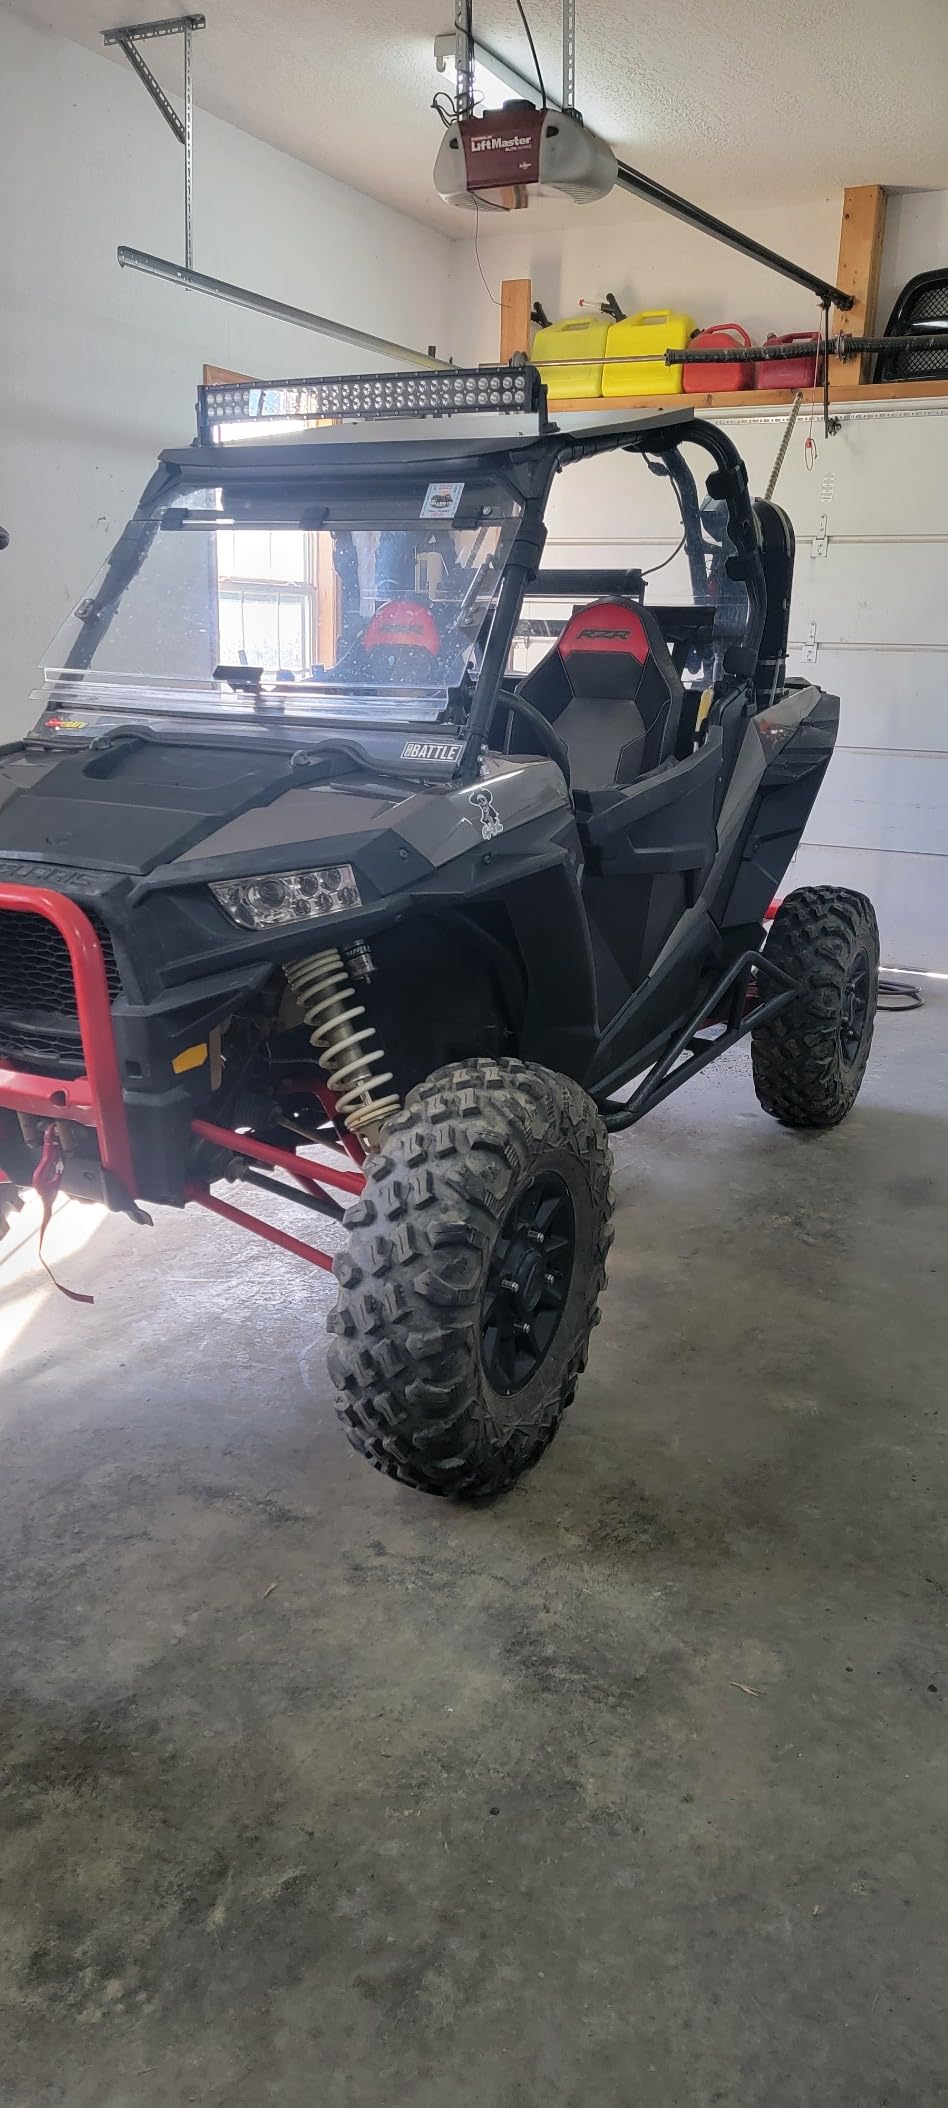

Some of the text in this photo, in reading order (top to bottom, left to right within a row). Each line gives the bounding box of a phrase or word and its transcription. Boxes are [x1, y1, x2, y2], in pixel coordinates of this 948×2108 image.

[471, 136, 532, 152] LiftMaster
[575, 629, 631, 641] RZR
[410, 744, 459, 760] BATTLE
[0, 863, 94, 886] OLARIS
